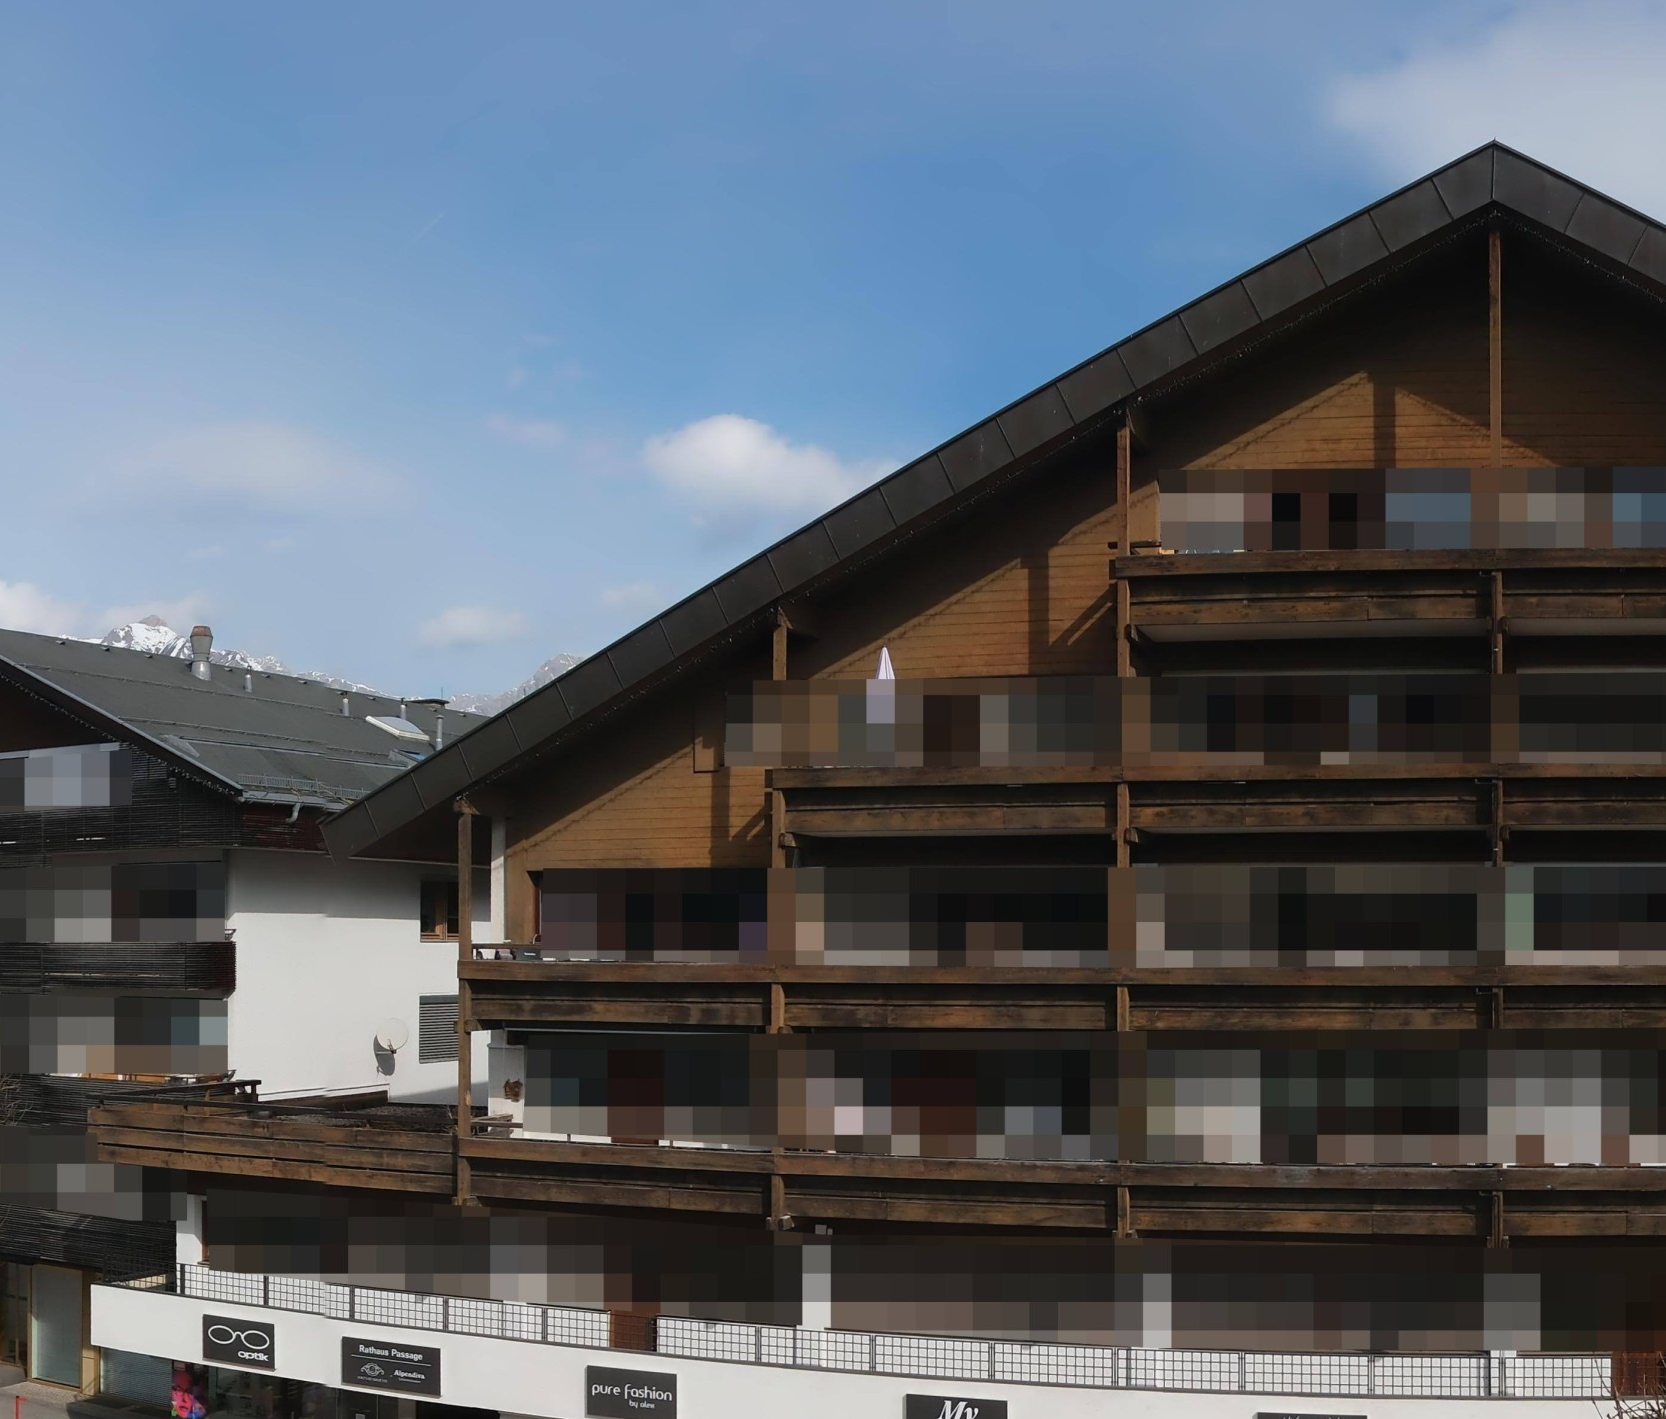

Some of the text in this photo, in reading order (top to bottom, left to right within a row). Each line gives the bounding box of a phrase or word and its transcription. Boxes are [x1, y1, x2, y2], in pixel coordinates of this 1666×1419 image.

[238, 1351, 269, 1361] optik
[359, 1344, 423, 1361] Rathaus Passage
[591, 1384, 672, 1401] pure fashion
